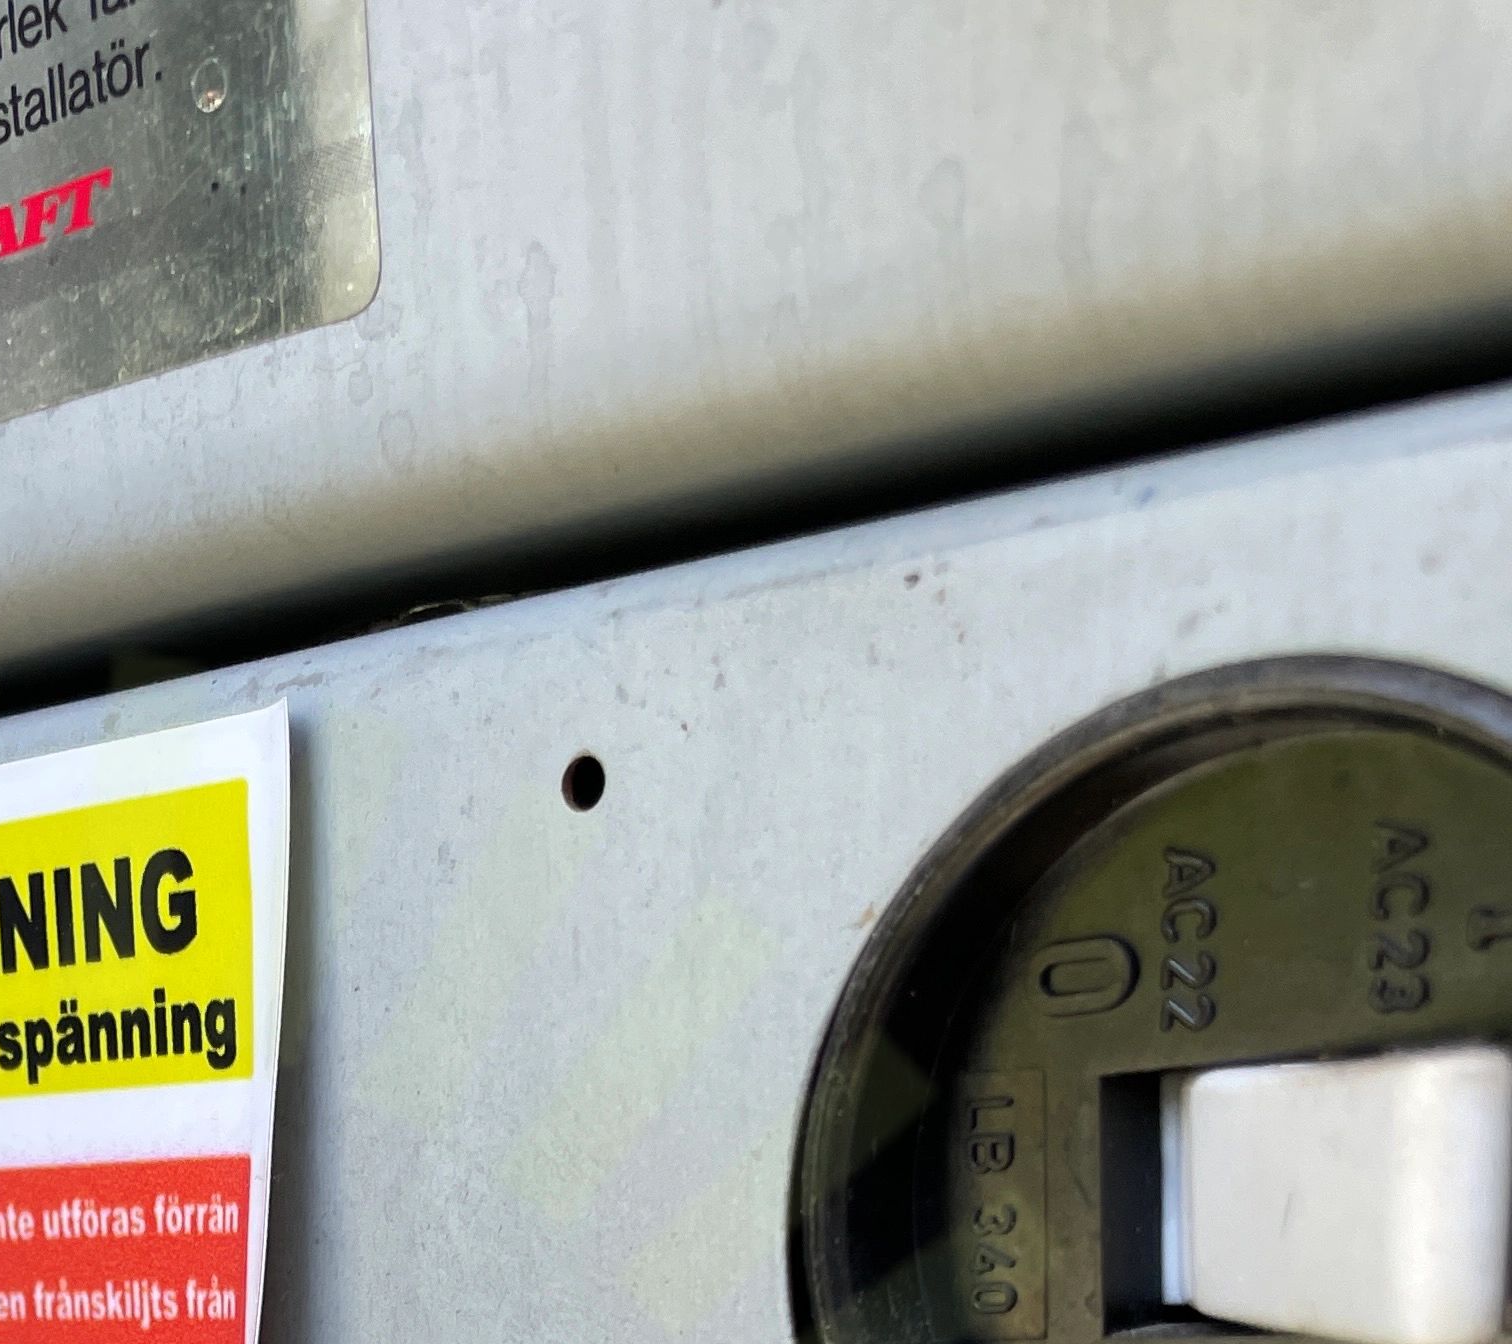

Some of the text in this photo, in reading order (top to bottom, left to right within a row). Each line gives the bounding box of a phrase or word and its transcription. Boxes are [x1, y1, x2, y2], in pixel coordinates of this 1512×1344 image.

[969, 1095, 1015, 1175] LB
[42, 1197, 147, 1239] utföras
[154, 1191, 240, 1235] förrän
[33, 1275, 179, 1331] frånskiljts
[185, 1273, 236, 1320] från
